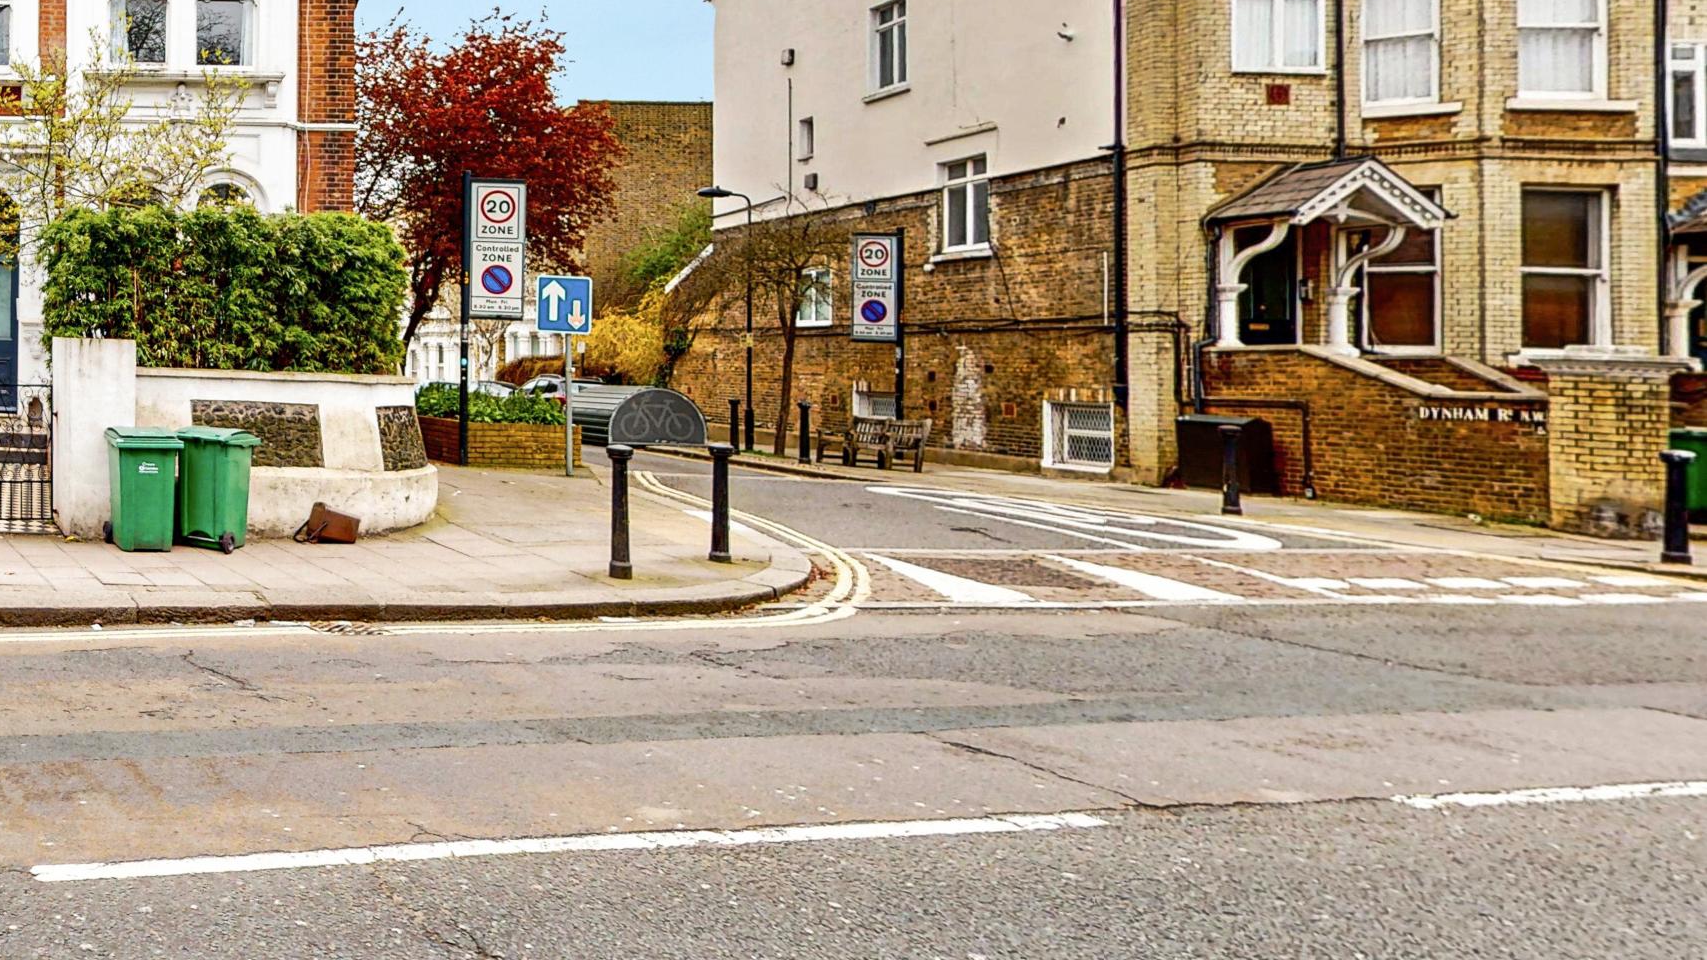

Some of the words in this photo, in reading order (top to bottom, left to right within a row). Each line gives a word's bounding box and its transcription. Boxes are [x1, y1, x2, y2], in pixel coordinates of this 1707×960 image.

[486, 200, 511, 214] 20
[481, 225, 514, 235] ZONE
[475, 244, 520, 253] Controlled
[482, 253, 513, 262] ZONE
[864, 248, 884, 260] 20
[861, 290, 886, 298] ZONE
[1419, 406, 1489, 421] DYNHAM
